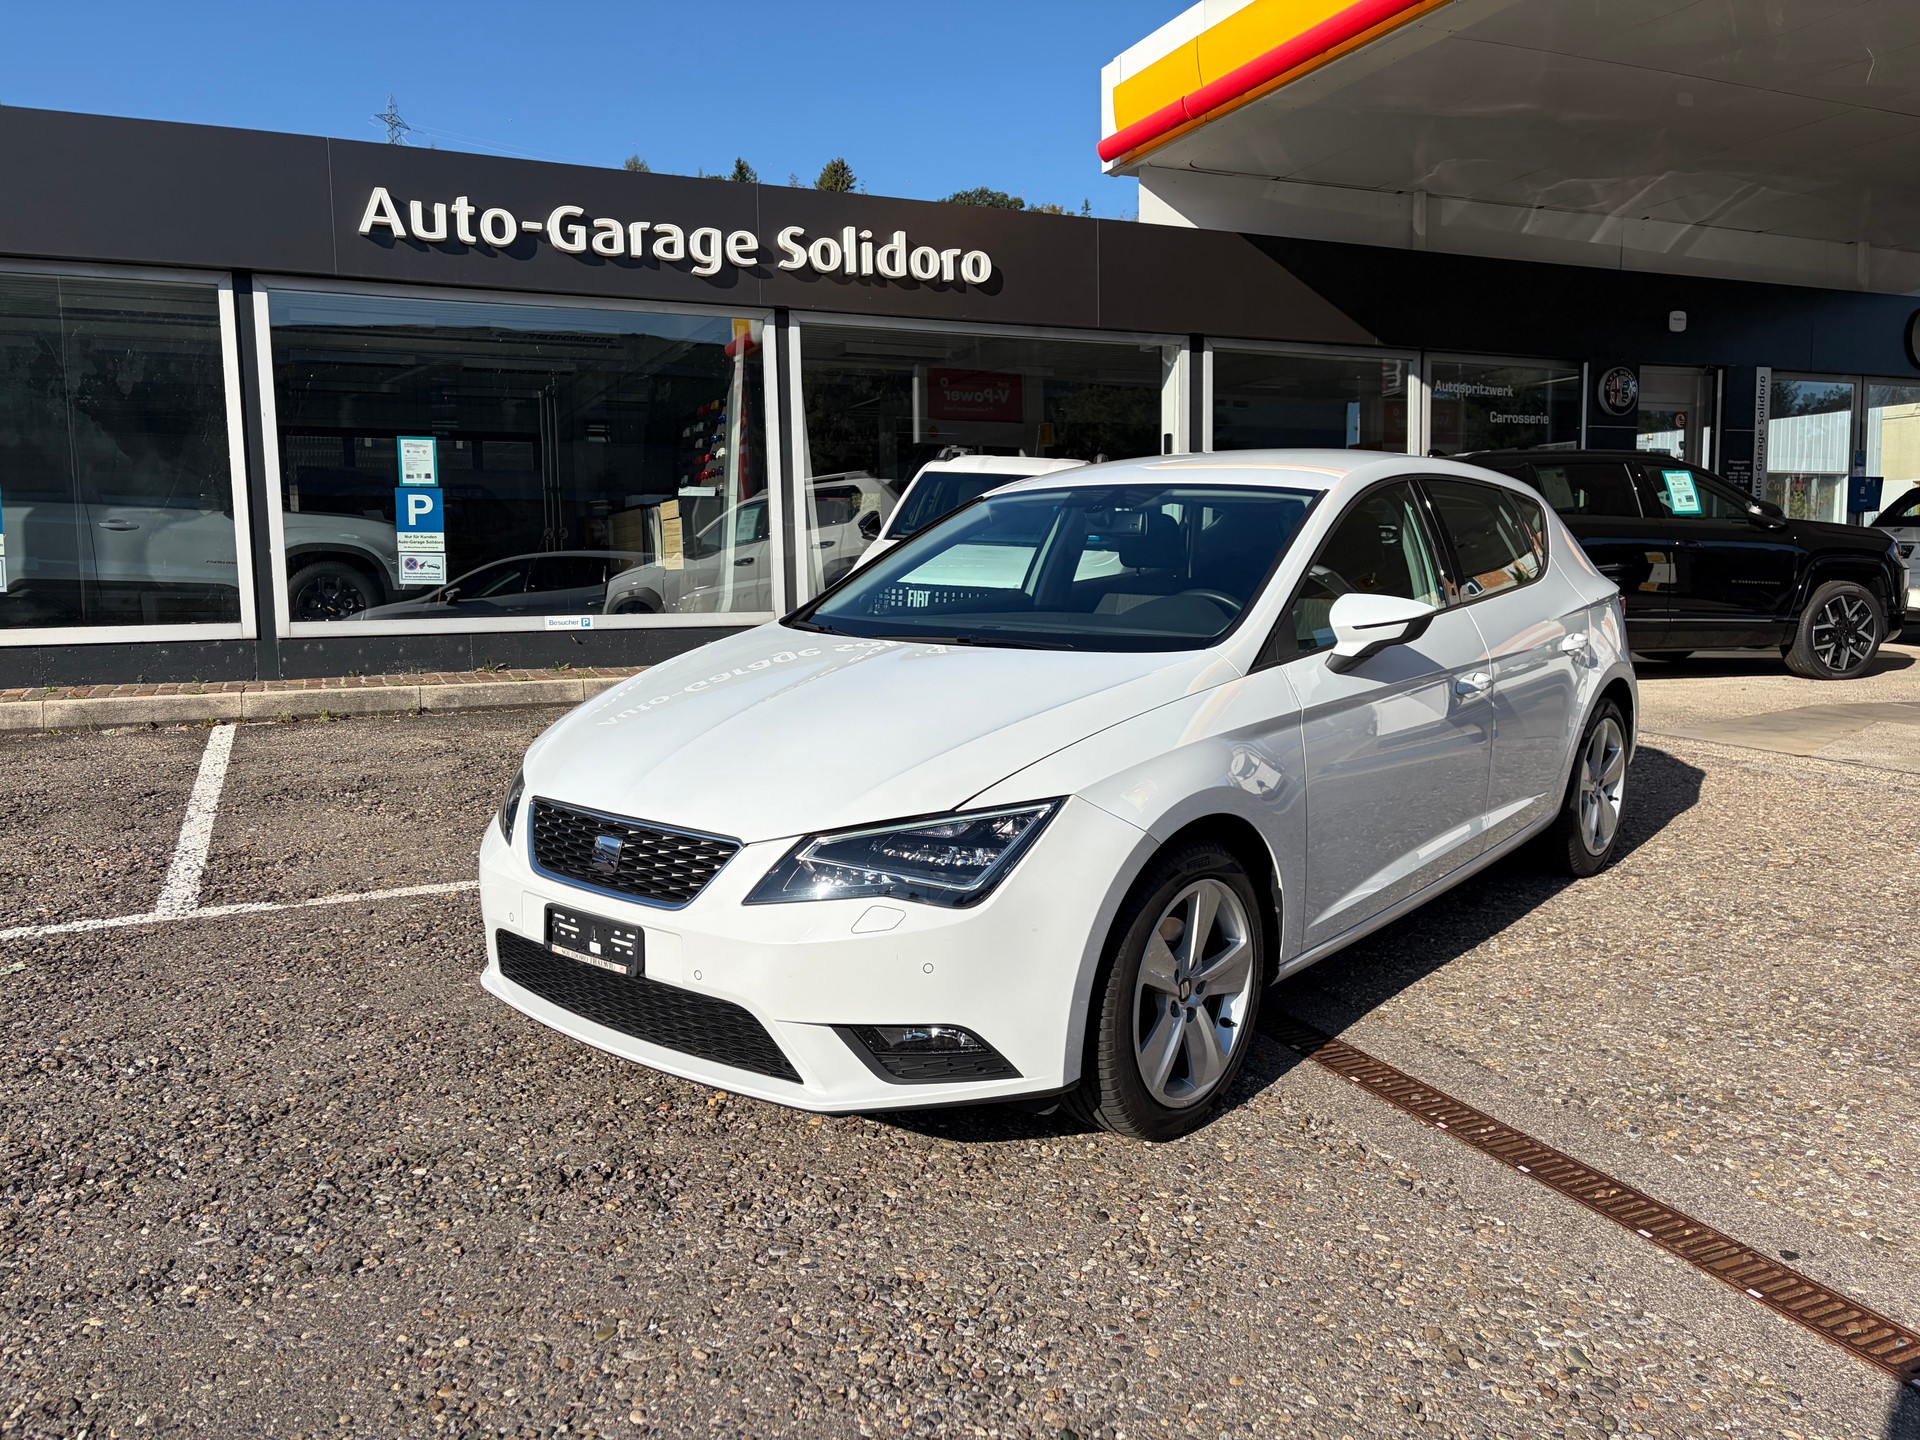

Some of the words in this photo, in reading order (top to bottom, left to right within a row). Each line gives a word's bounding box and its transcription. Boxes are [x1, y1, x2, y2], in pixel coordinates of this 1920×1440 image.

[359, 187, 758, 276] Auto-Garage
[777, 225, 993, 285] Solidoro
[1434, 379, 1514, 398] Autospritzwerk
[1757, 375, 1766, 425] Solidoro
[1489, 411, 1549, 425] Carrosserie
[1756, 429, 1766, 499] uto-Garage
[407, 494, 434, 526] P
[907, 590, 931, 608] FIAT
